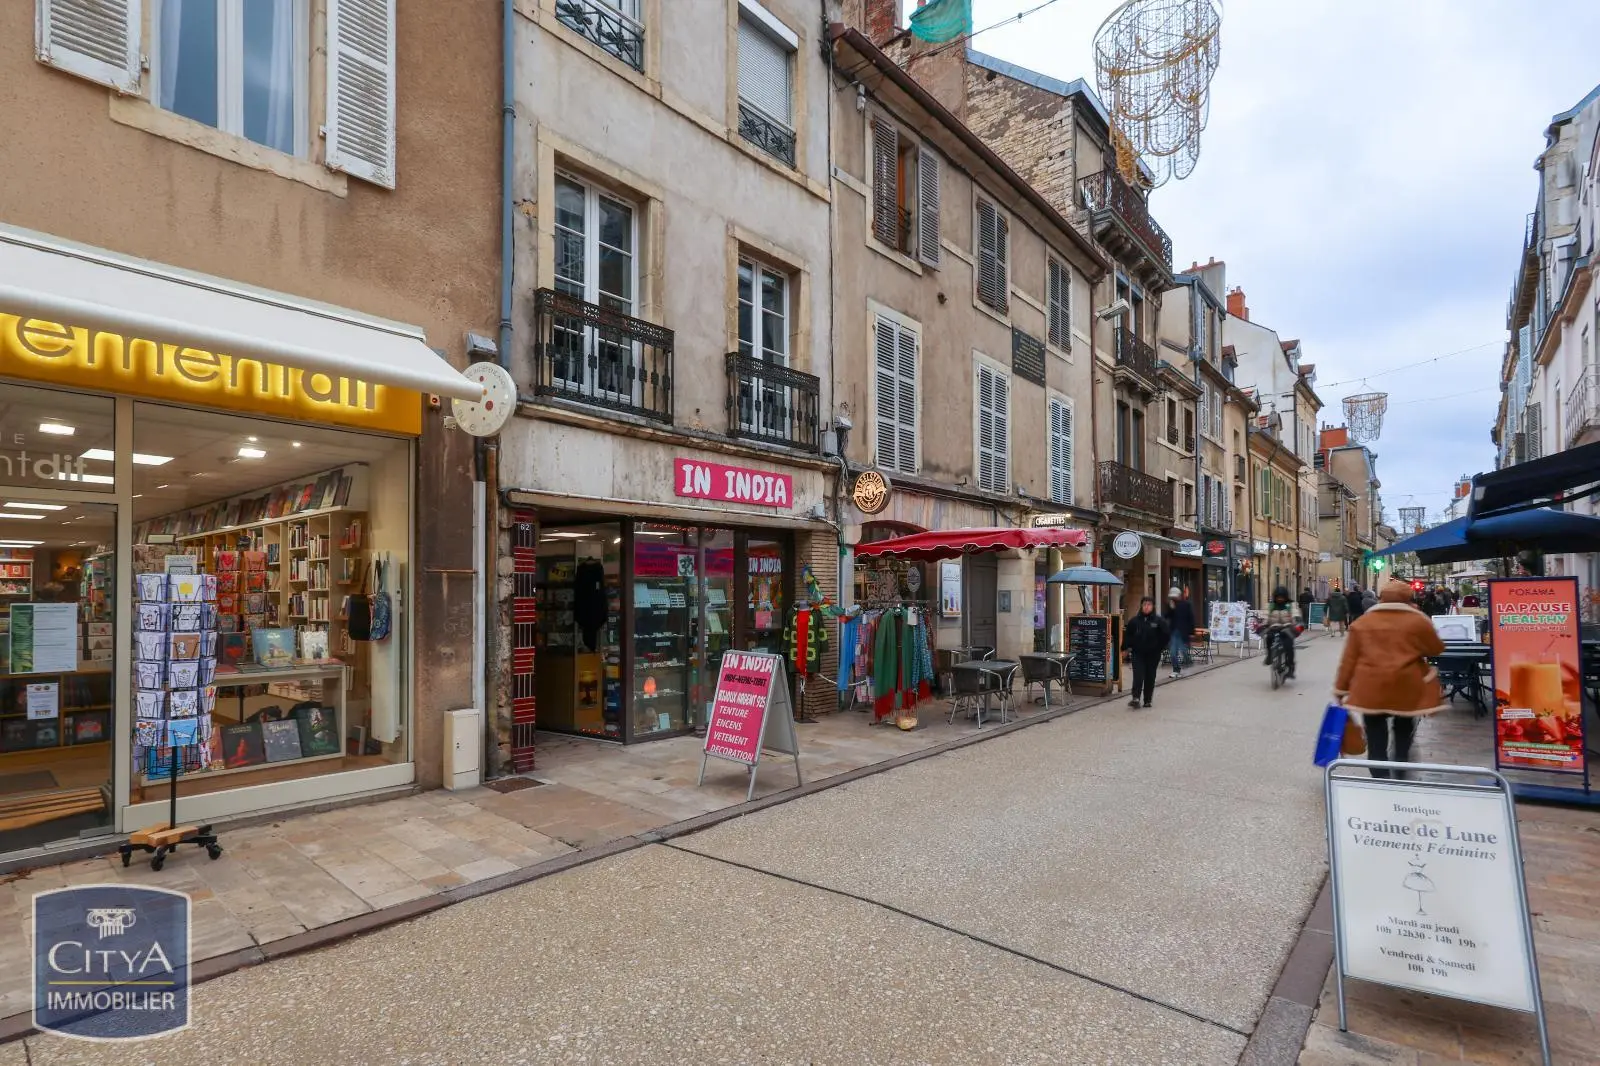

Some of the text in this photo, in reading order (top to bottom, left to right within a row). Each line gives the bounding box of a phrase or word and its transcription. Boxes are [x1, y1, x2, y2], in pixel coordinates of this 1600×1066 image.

[682, 463, 787, 505] IN INDIA
[1035, 516, 1065, 526] CIGARETTES
[748, 557, 758, 573] IN
[760, 557, 782, 573] INDIA
[1496, 603, 1570, 614] LA PAUSE
[1501, 614, 1567, 625] HEALTHY
[724, 653, 774, 674] IN INDIA
[756, 695, 767, 708] 925
[720, 705, 750, 718] TENTURE
[716, 718, 743, 731] ENCENS
[713, 730, 749, 746] VETEMENT
[711, 744, 754, 761] DECORATION
[1393, 803, 1442, 817] Boutique
[1347, 816, 1499, 845] Graine de Lune
[1353, 834, 1497, 861] Vêtements Féminins
[1388, 916, 1460, 935] Mardi au jeudi
[1376, 924, 1392, 935] 10h
[1397, 927, 1426, 941] 12h30
[1435, 934, 1452, 945] 14h
[1458, 938, 1476, 949] 19h
[1380, 945, 1476, 972] Vendredi & Samedi
[1408, 962, 1448, 978] 10h 19h
